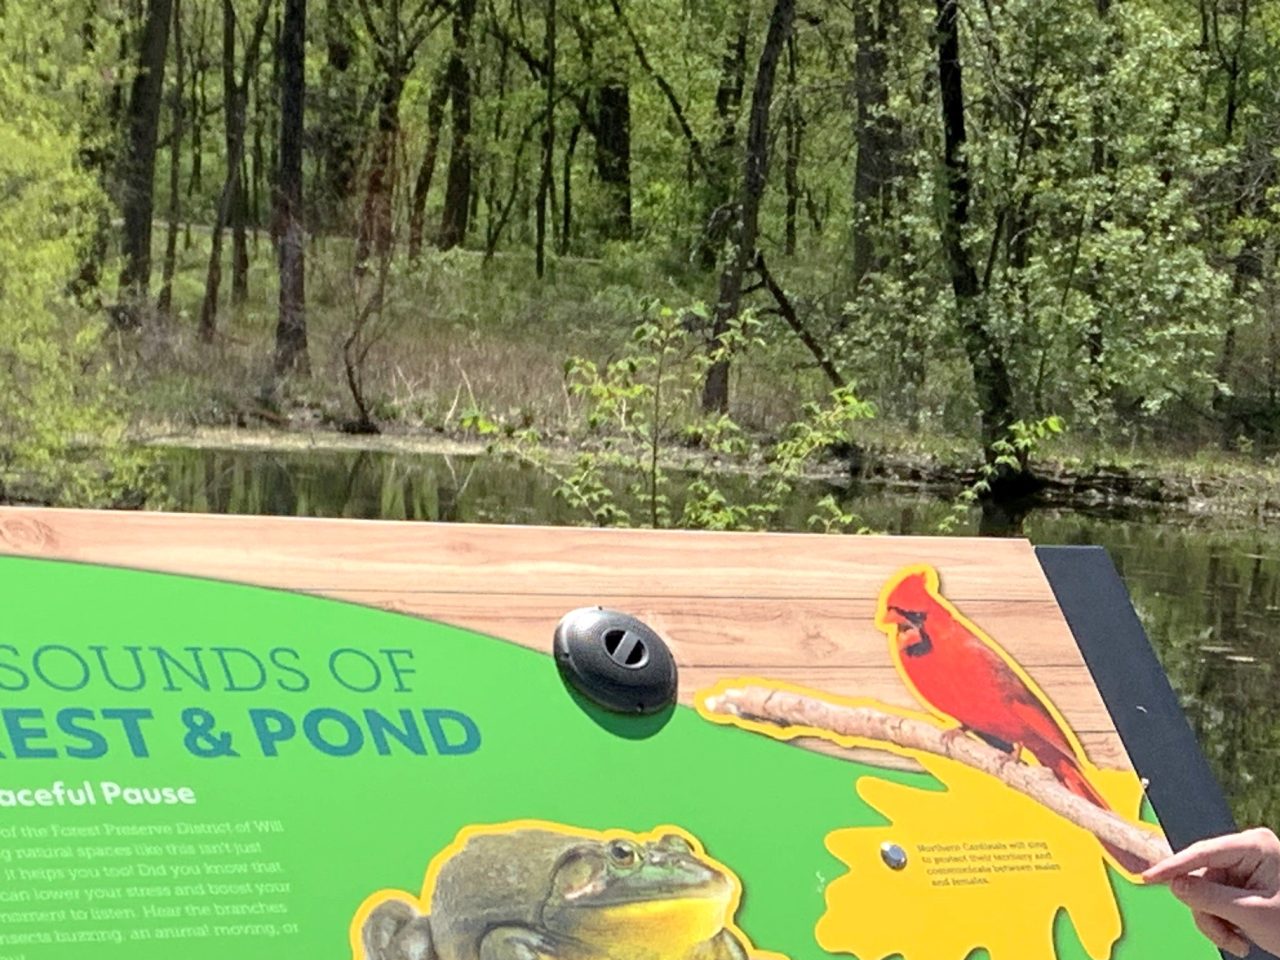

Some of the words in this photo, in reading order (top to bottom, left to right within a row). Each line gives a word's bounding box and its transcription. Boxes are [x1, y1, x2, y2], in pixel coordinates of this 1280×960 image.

[0, 644, 310, 692] SOUNDS
[328, 647, 416, 693] OF
[0, 706, 154, 760] EST
[180, 706, 241, 758] &
[248, 706, 482, 758] POND
[100, 781, 197, 805] Pause
[20, 825, 47, 838] the
[49, 823, 99, 837] Forest
[102, 822, 172, 836] Preserve
[176, 821, 232, 834] District
[235, 821, 251, 833] of
[253, 819, 285, 833] Will
[15, 846, 73, 858] natural
[76, 846, 131, 859] spaces
[130, 843, 163, 856] like
[165, 843, 195, 855] this
[198, 841, 231, 855] isn't
[233, 841, 262, 855] just
[917, 842, 961, 852] Northern
[963, 841, 1007, 851] Cardinals
[1009, 840, 1026, 849] will
[1028, 839, 1048, 850] sing
[934, 854, 967, 865] protect
[969, 853, 991, 862] their
[993, 852, 1033, 863] territory
[1035, 851, 1052, 860] and
[18, 867, 65, 882] helps
[68, 867, 100, 881] you
[137, 863, 167, 877] Did
[169, 864, 201, 879] you
[203, 861, 248, 875] know
[250, 861, 282, 874] that
[926, 865, 992, 876] communicate
[992, 863, 1033, 873] between
[1035, 862, 1061, 871] males
[0, 889, 30, 901] can
[32, 888, 80, 901] lower
[84, 887, 122, 901] your
[125, 885, 171, 898] stress
[174, 883, 206, 896] and
[207, 882, 253, 895] boost
[254, 882, 290, 896] your
[931, 878, 950, 887] and
[69, 908, 89, 920] to
[141, 904, 181, 918] Hear
[184, 904, 211, 916] the
[212, 902, 288, 916] branches
[129, 928, 150, 940] an
[154, 923, 209, 939] animal
[212, 924, 280, 939] moving,
[282, 922, 299, 935] or
